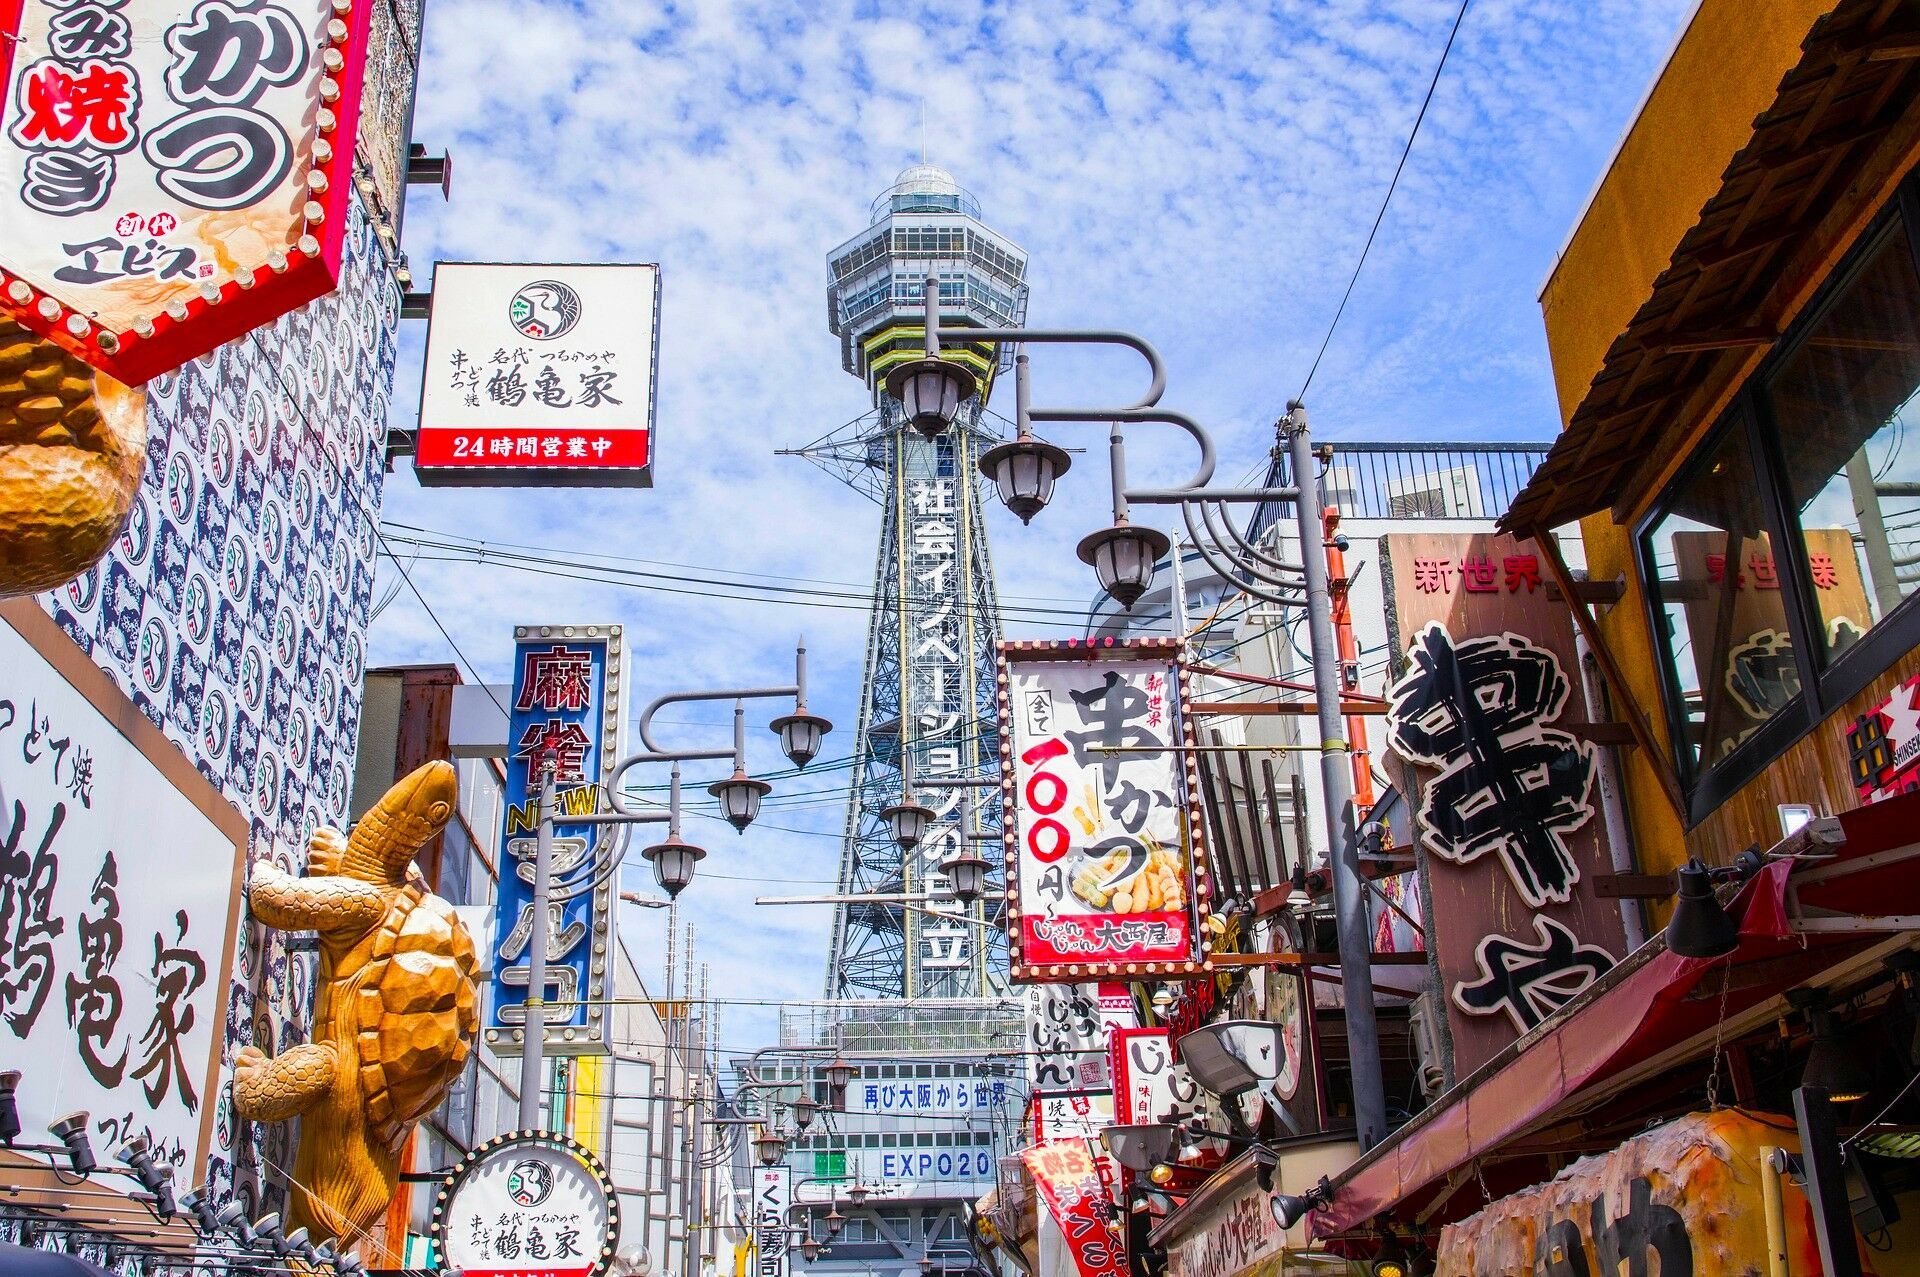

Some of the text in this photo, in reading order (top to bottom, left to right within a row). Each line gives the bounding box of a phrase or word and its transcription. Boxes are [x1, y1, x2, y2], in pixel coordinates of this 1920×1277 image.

[12, 8, 138, 213] み焼き
[147, 3, 305, 207] かつ
[116, 212, 177, 237] 初代
[488, 347, 533, 365] 名代
[539, 350, 617, 365] つるかめや
[485, 364, 624, 409] 鶴亀家
[453, 436, 613, 458] 24時間営業中
[1414, 555, 1543, 595] 新世界
[511, 645, 593, 784] 麻雀
[914, 478, 972, 968] 社会イノベーションの日立
[1028, 694, 1051, 732] 全て
[1063, 671, 1173, 888] 串かつ
[1095, 921, 1177, 951] 大西屋
[1068, 984, 1096, 1038] かつ
[864, 1082, 1006, 1110] 再び大阪から世界
[883, 1152, 990, 1178] EXPO20
[496, 1212, 526, 1226] 名代
[493, 1225, 584, 1261] 鶴亀家
